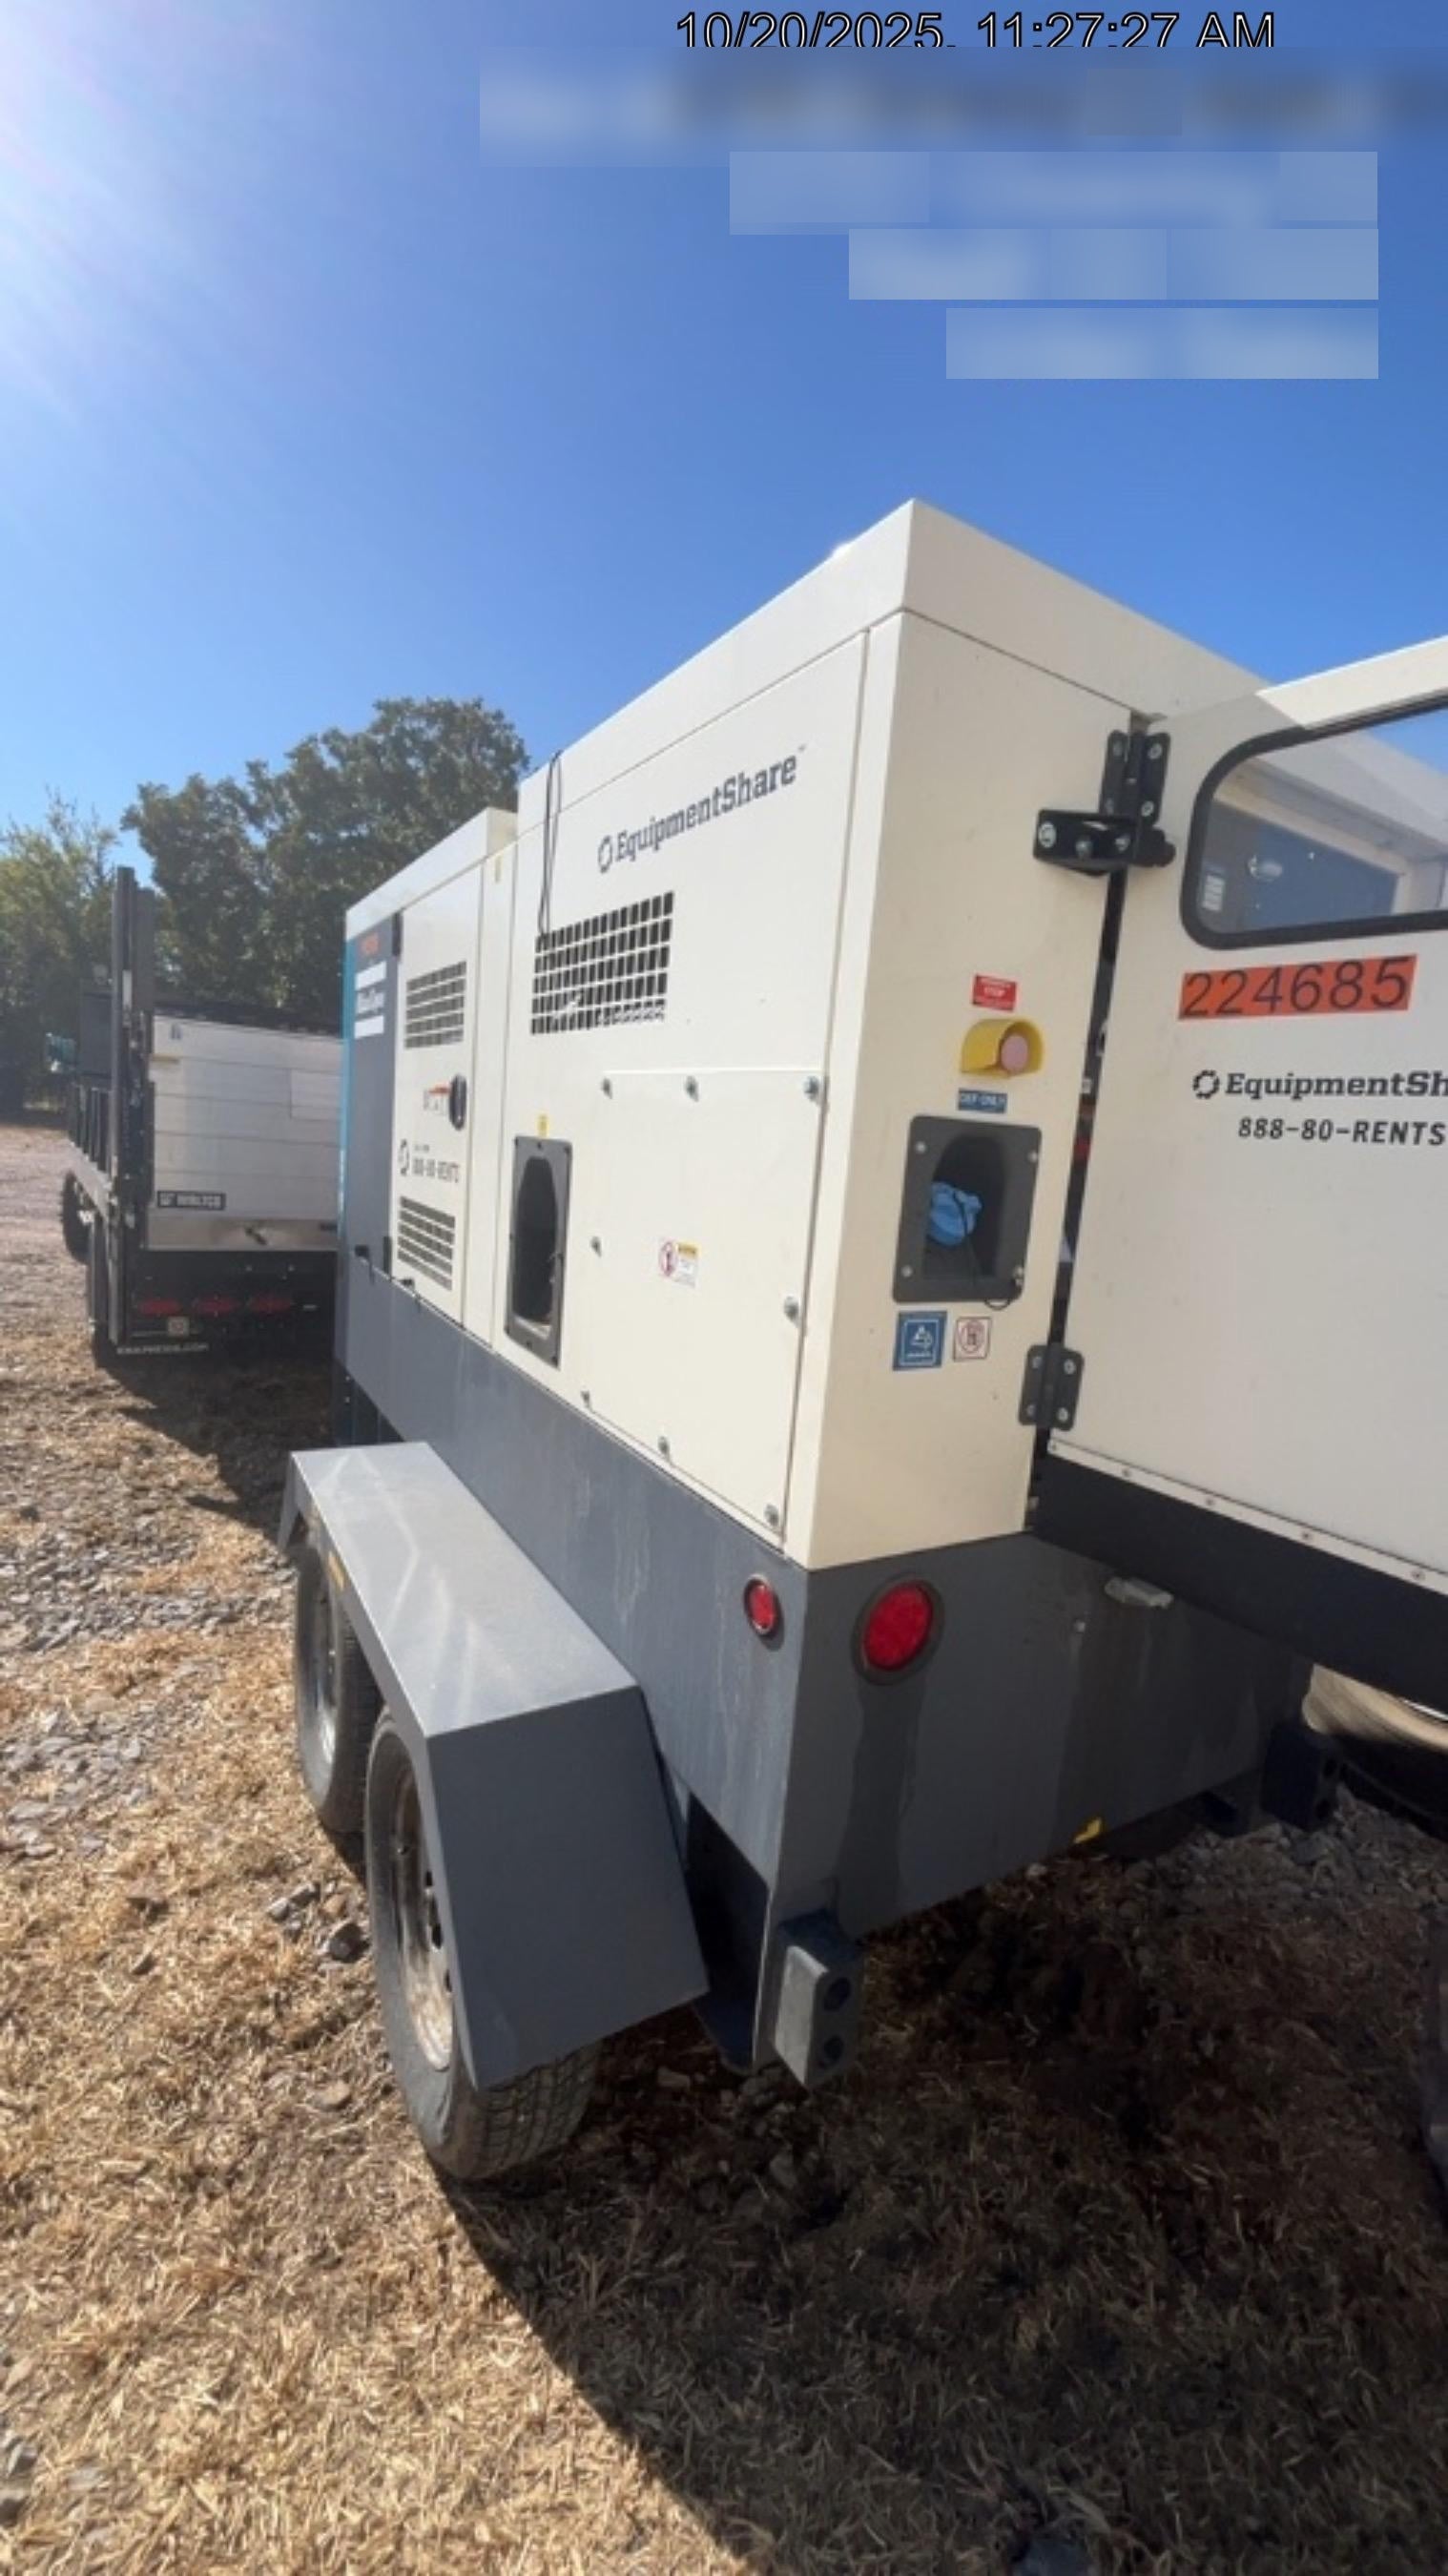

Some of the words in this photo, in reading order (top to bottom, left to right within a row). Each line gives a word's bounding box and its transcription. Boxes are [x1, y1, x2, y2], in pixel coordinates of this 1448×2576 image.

[615, 755, 797, 862] EquipmentShare
[1182, 956, 1412, 1019] 224685
[1238, 1116, 1446, 1146] 888-80-RENTS
